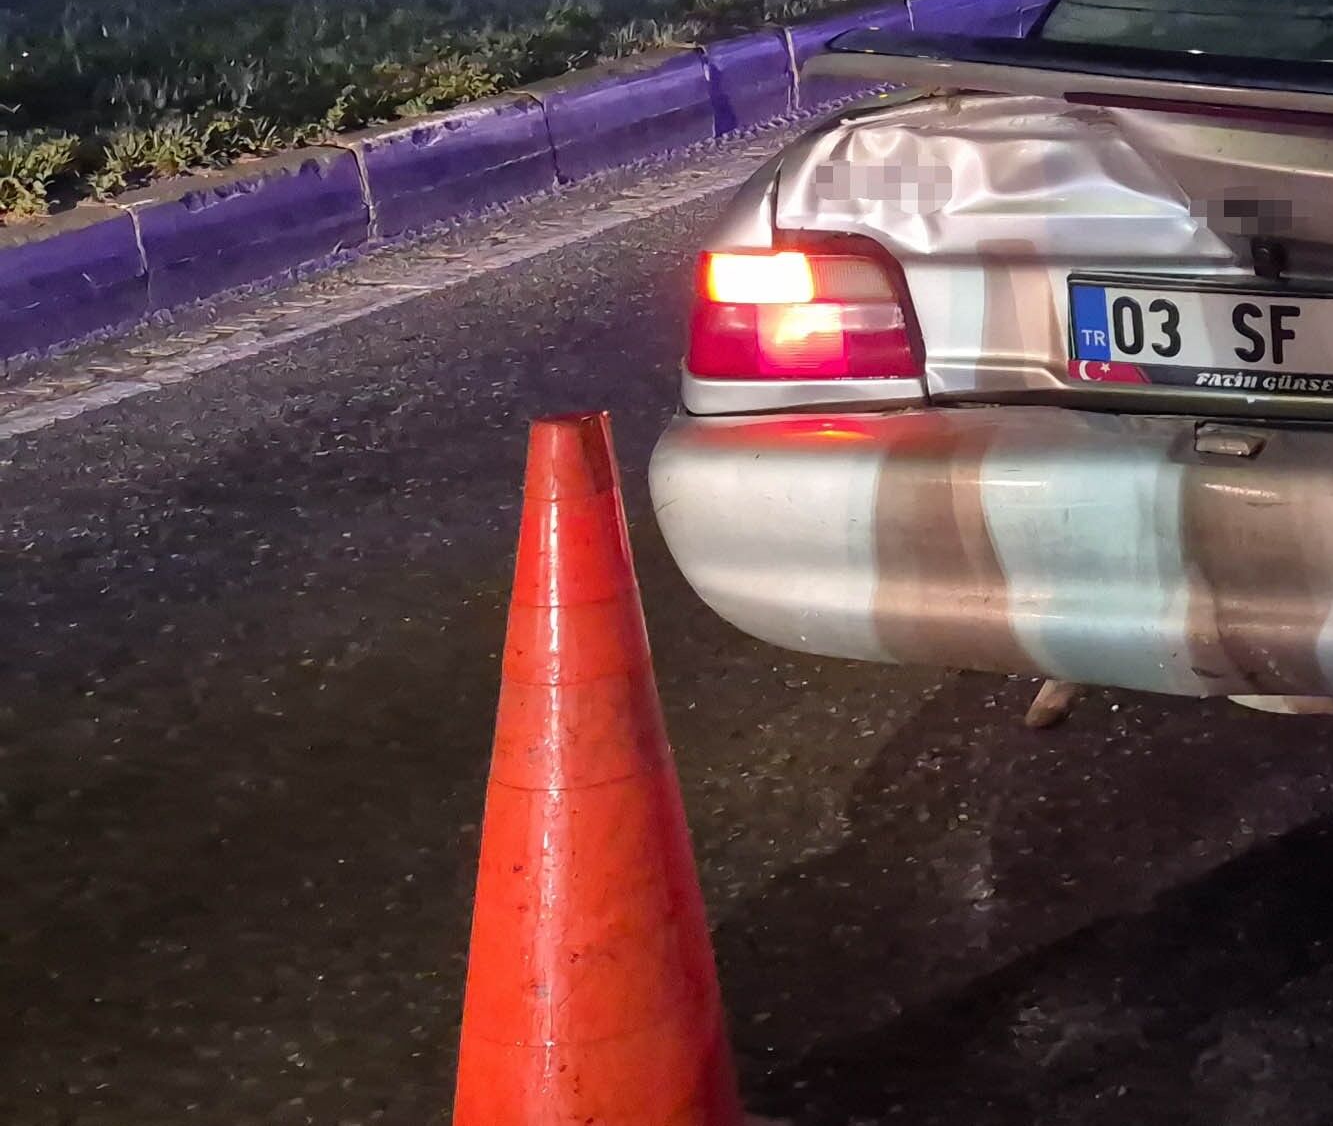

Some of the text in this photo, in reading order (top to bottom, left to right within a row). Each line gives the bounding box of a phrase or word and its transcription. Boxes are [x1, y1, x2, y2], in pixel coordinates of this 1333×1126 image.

[1081, 329, 1106, 346] TR
[1112, 296, 1181, 357] 03
[1231, 303, 1300, 364] SF
[1195, 372, 1258, 388] FATİH
